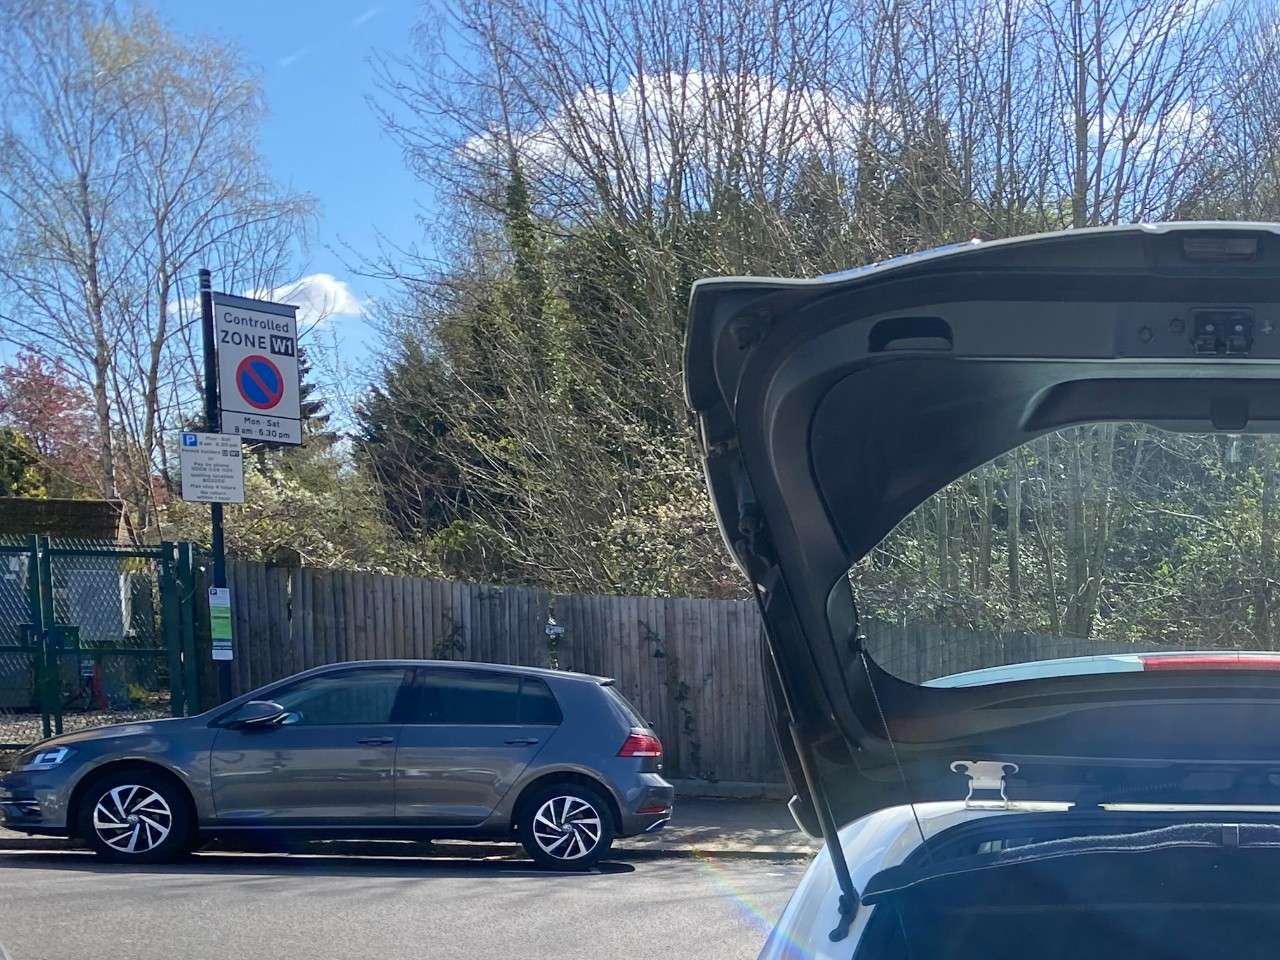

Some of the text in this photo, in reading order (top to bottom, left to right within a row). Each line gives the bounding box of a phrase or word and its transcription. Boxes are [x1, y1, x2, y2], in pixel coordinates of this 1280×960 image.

[223, 312, 289, 333] Controlled
[220, 329, 294, 356] ZONE W1
[243, 416, 260, 426] Mon
[266, 418, 280, 428] Sat
[241, 427, 253, 435] am
[278, 430, 290, 439] pm
[186, 434, 196, 446] P
